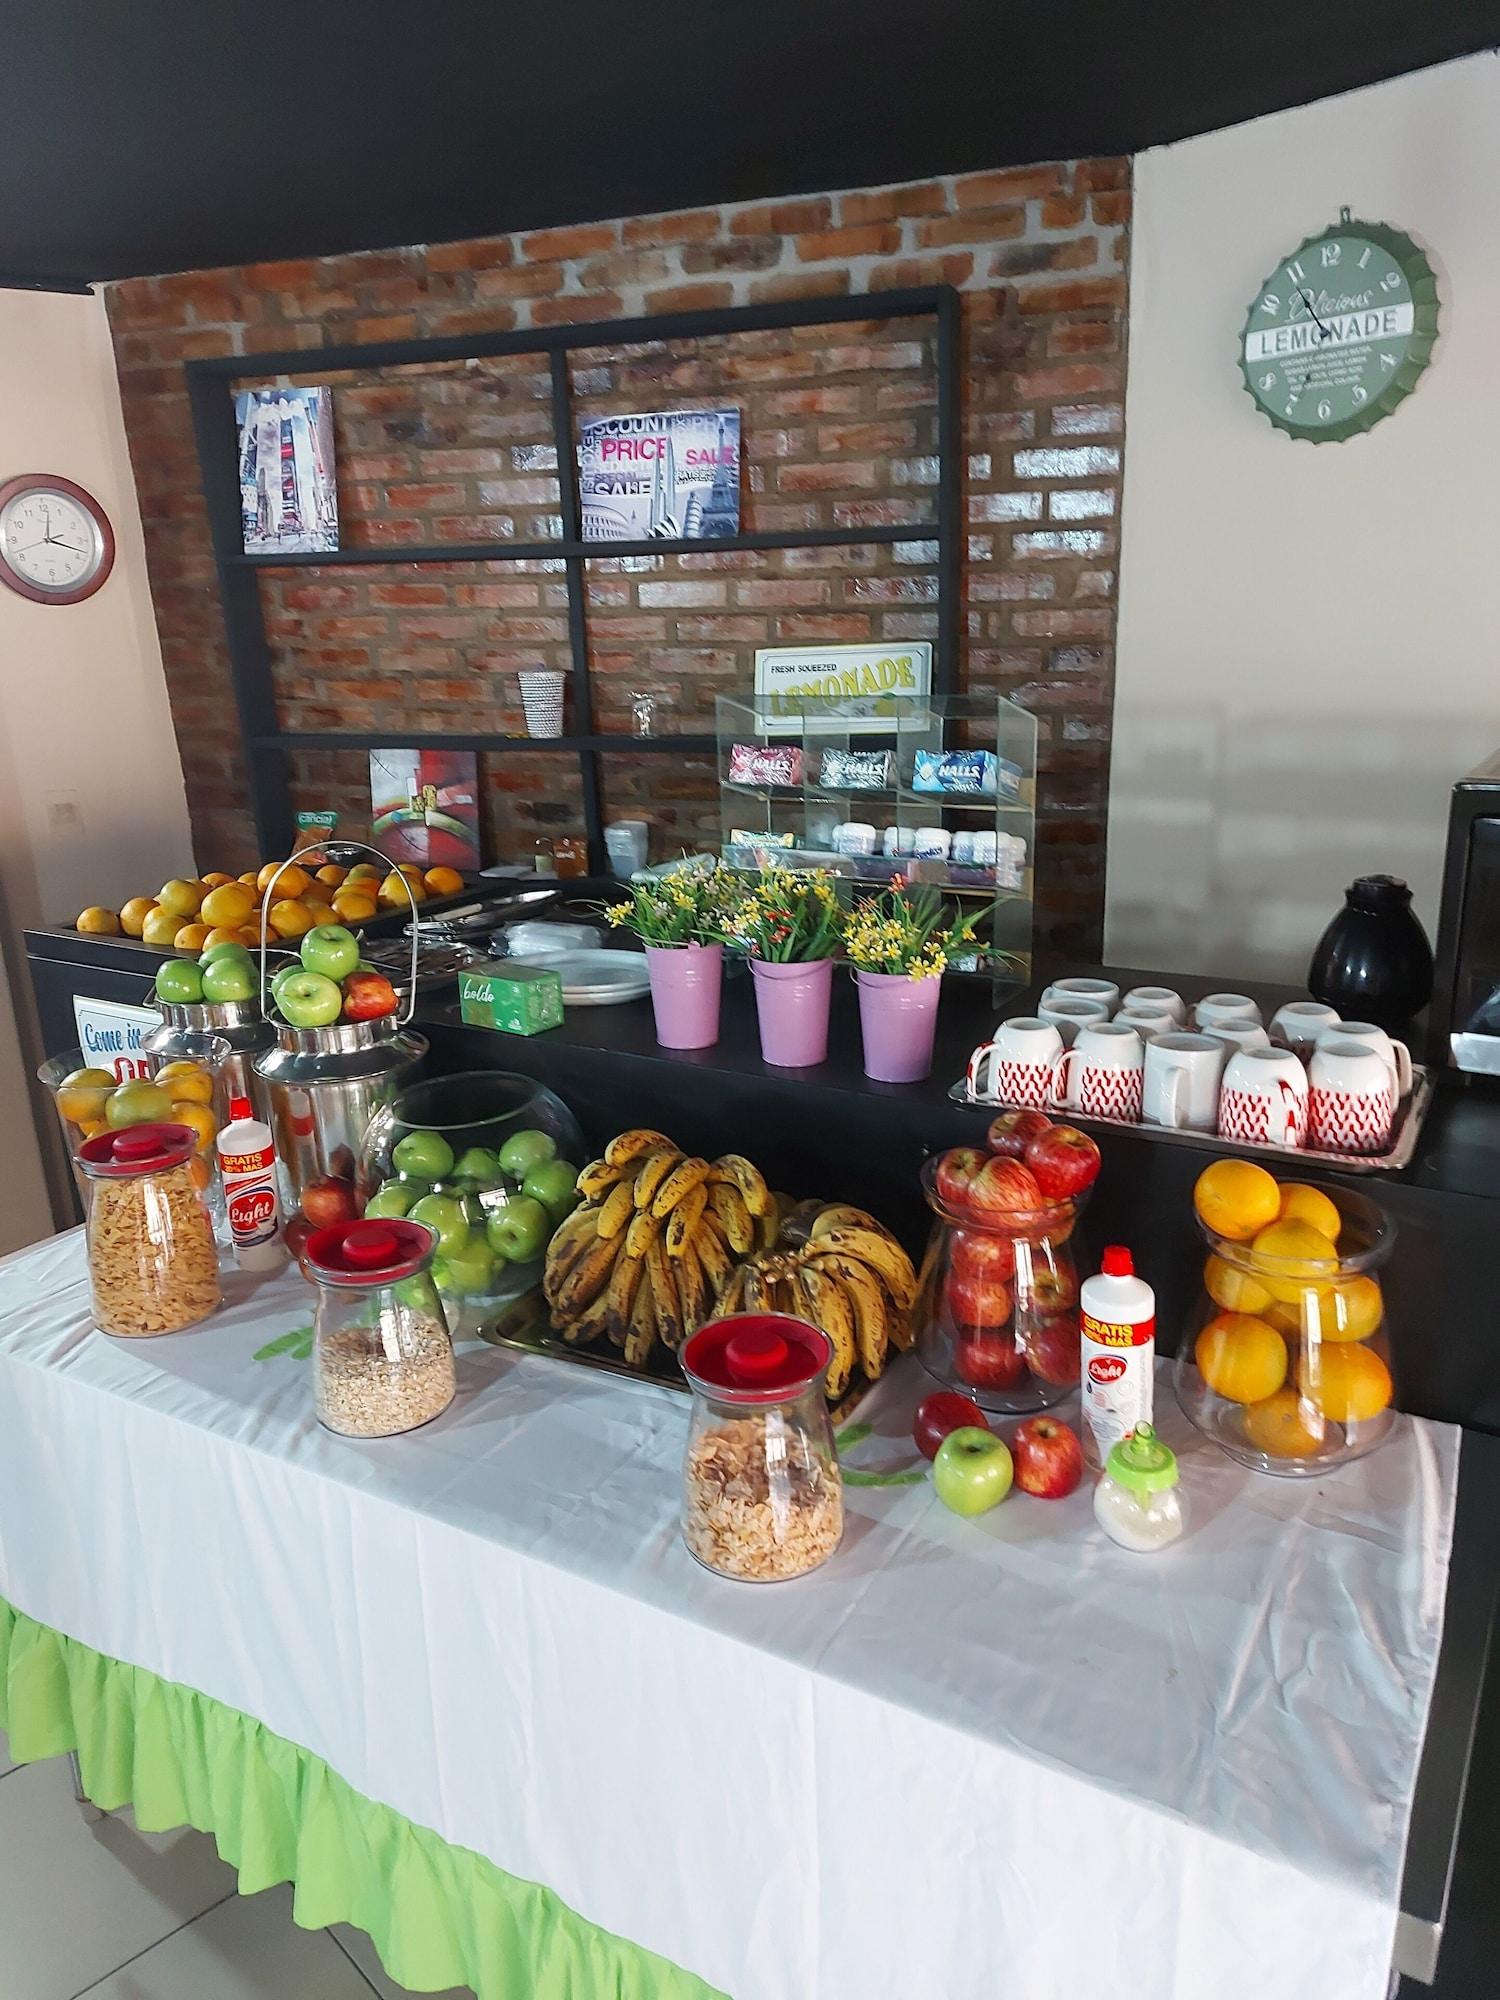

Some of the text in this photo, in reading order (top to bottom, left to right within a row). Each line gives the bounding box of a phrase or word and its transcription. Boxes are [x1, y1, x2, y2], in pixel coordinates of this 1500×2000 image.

[1260, 309, 1398, 355] LEMONADE
[601, 437, 667, 461] PRICE
[771, 663, 837, 673] FRESH SQUEEZED
[769, 656, 916, 719] LEMONADE
[938, 765, 981, 779] HALLS
[84, 1023, 122, 1053] Come
[223, 1153, 263, 1166] GRATIS
[231, 1201, 270, 1225] Light
[1084, 1315, 1133, 1338] GRATIS
